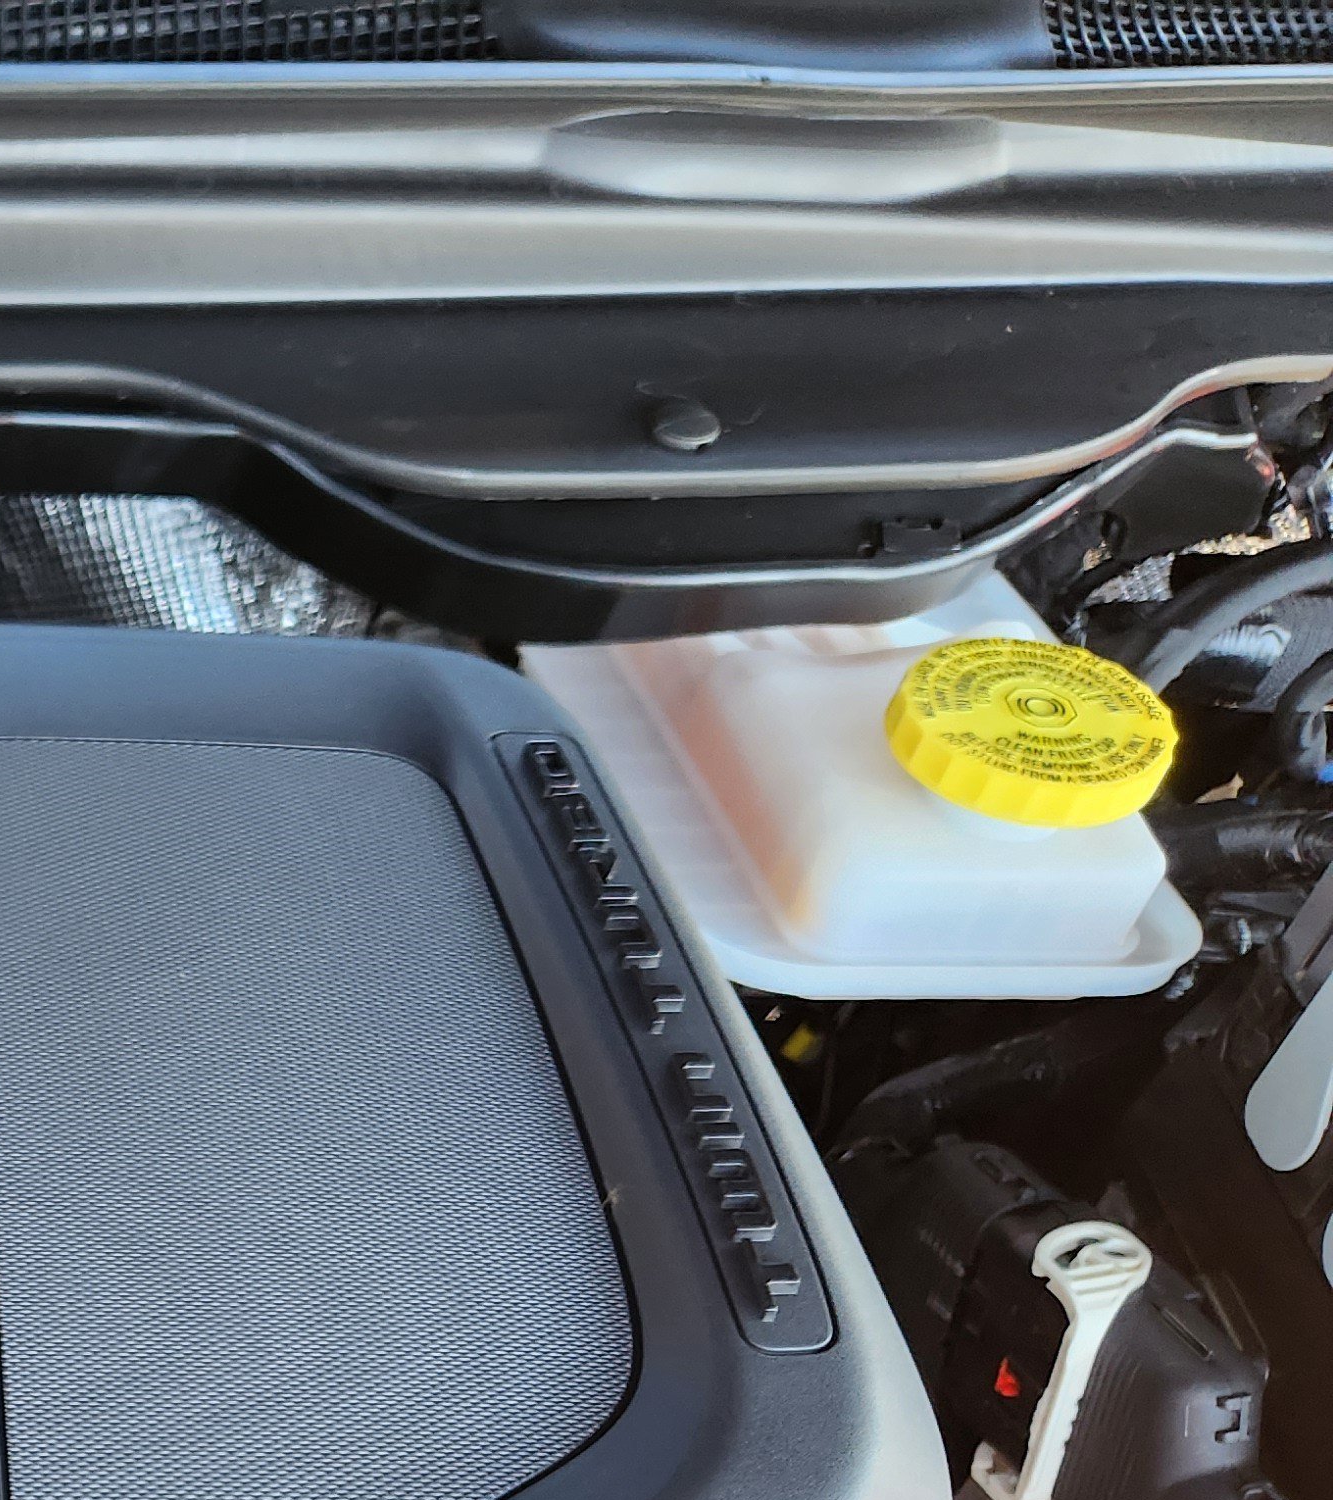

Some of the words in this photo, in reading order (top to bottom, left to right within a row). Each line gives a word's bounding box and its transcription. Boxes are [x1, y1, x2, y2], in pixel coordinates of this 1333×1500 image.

[941, 732, 969, 748] DOT
[978, 753, 1018, 774] FLUID
[1020, 769, 1062, 783] FROM
[1078, 769, 1128, 783] SEALED
[1123, 738, 1166, 774] CONTAINER
[961, 731, 1018, 762] BEFORE
[996, 737, 1043, 757] CLEAN
[1049, 744, 1099, 759] FILLER
[1017, 730, 1091, 747] WARNING
[525, 740, 685, 1034] TURBO
[670, 1053, 801, 1322] TWIN
